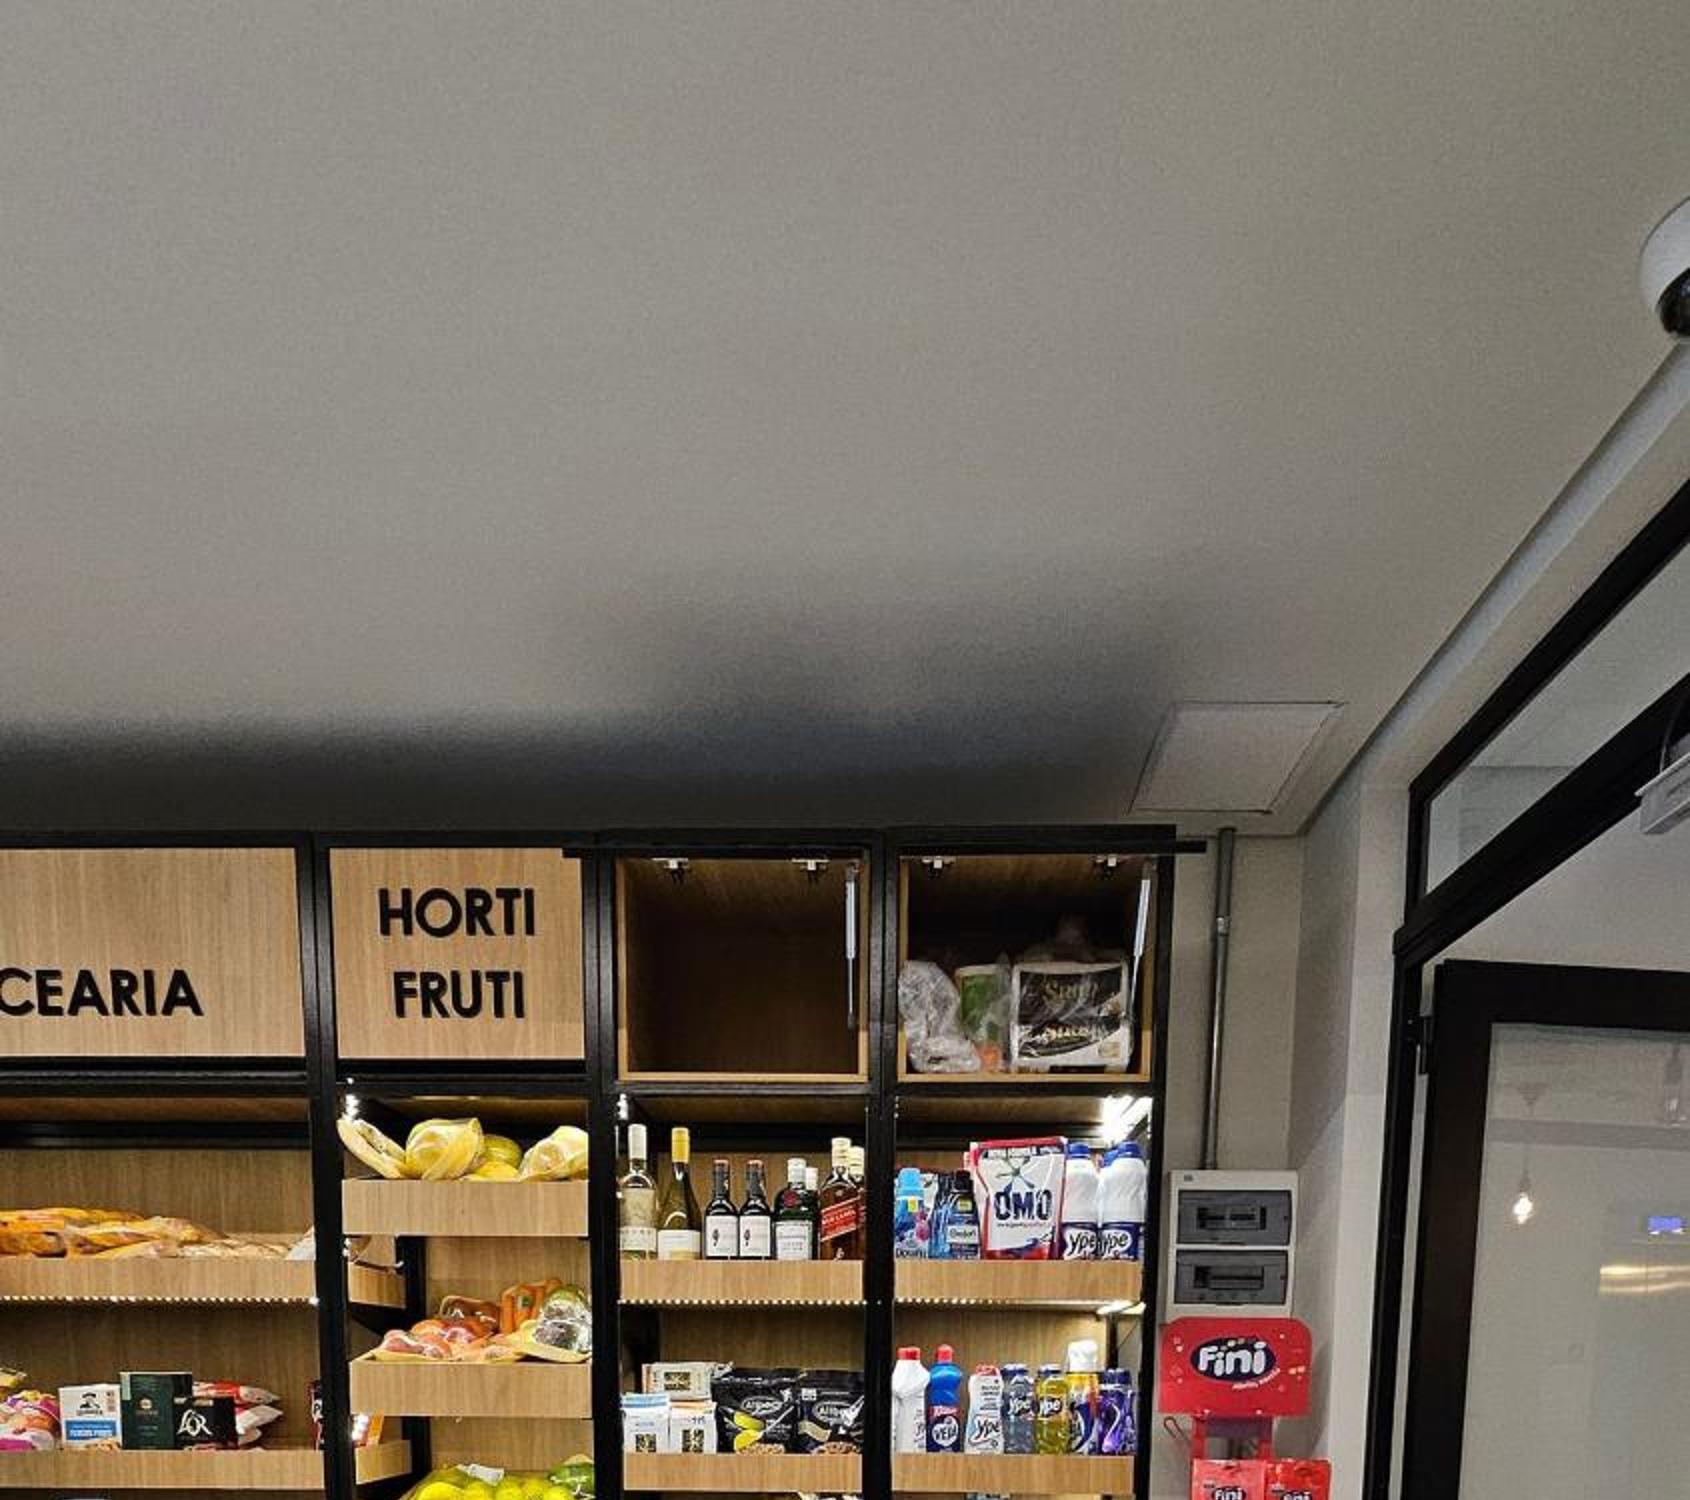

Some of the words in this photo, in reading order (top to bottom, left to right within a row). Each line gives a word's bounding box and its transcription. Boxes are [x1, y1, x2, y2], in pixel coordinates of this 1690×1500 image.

[379, 887, 535, 938] HORTI
[0, 967, 204, 1016] CEARIA
[394, 970, 525, 1018] FRUTI
[995, 1190, 1053, 1221] OMO
[1198, 1341, 1267, 1377] Fini
